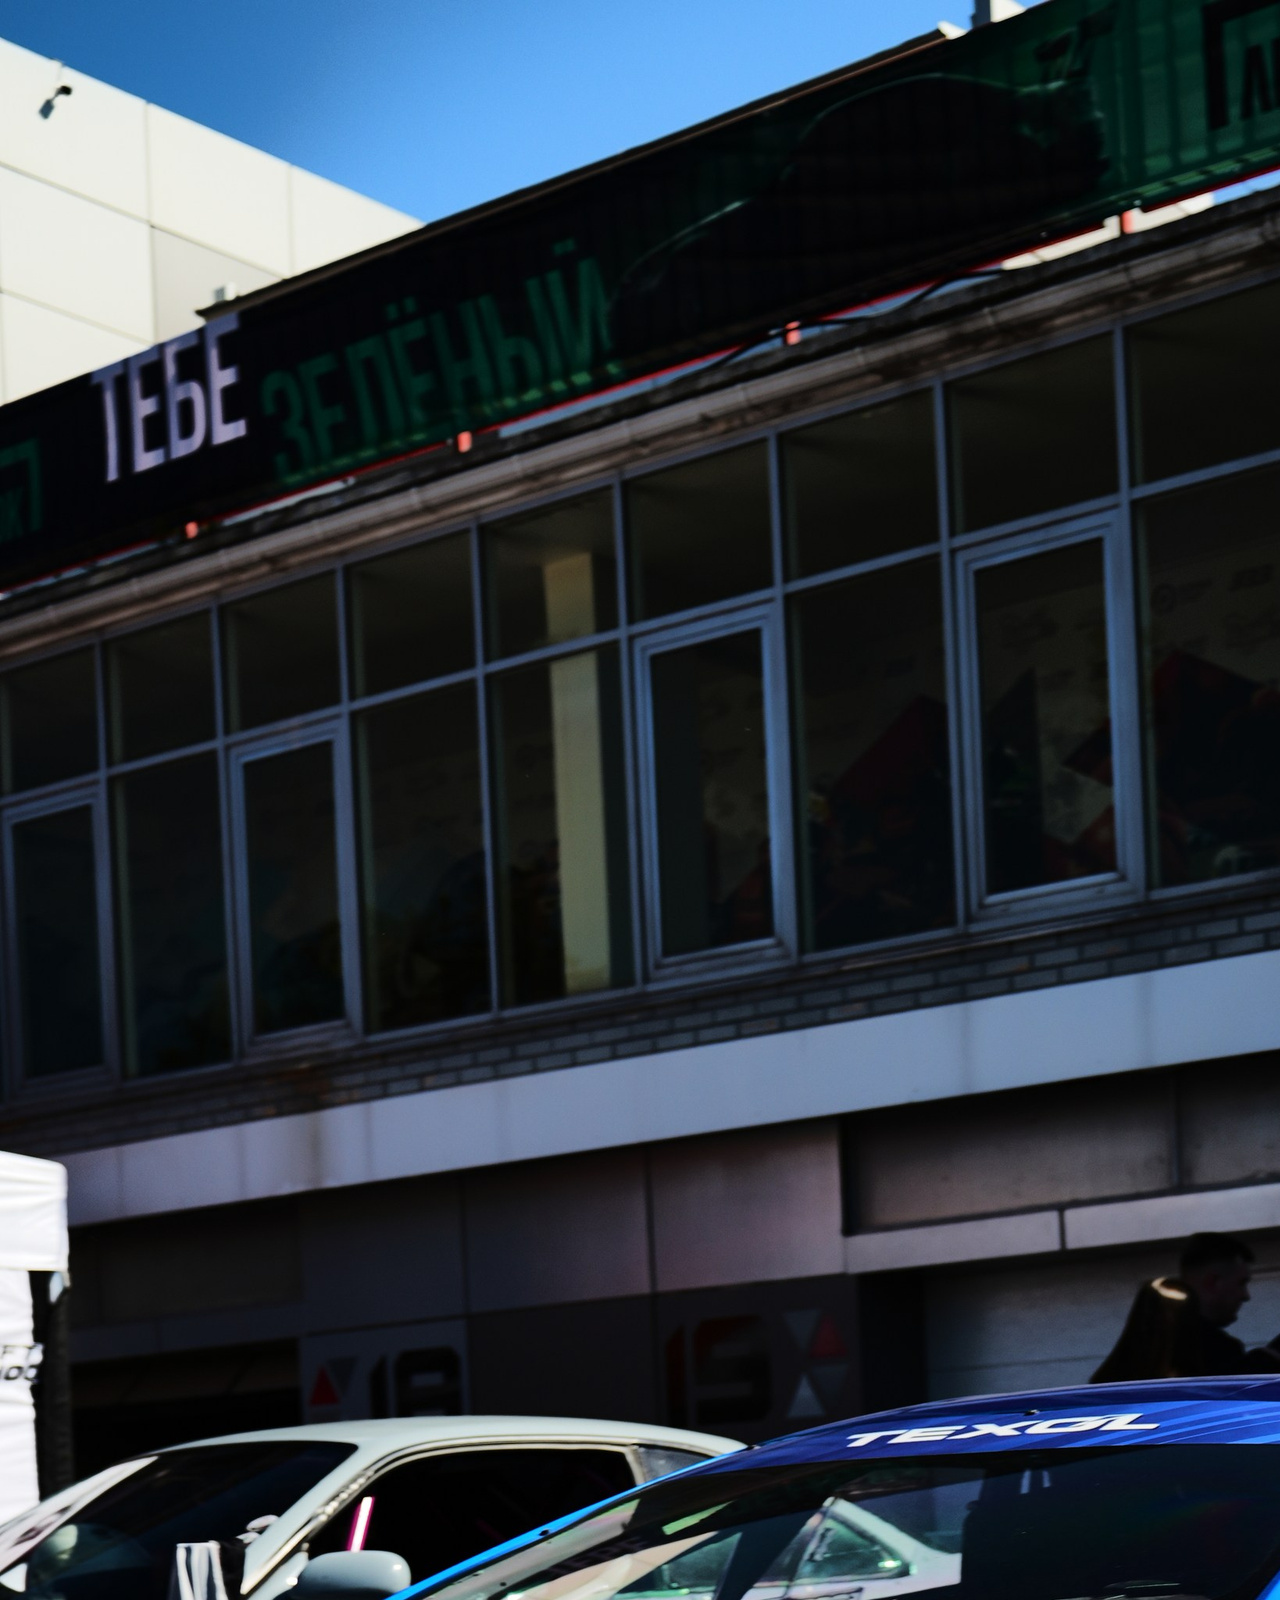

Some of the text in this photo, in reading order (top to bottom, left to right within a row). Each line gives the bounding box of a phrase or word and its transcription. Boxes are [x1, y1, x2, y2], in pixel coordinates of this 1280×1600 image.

[91, 237, 614, 488] ТЕБЕ ЗЕЛЁНЫЙ
[846, 1413, 1161, 1448] TEXOL
